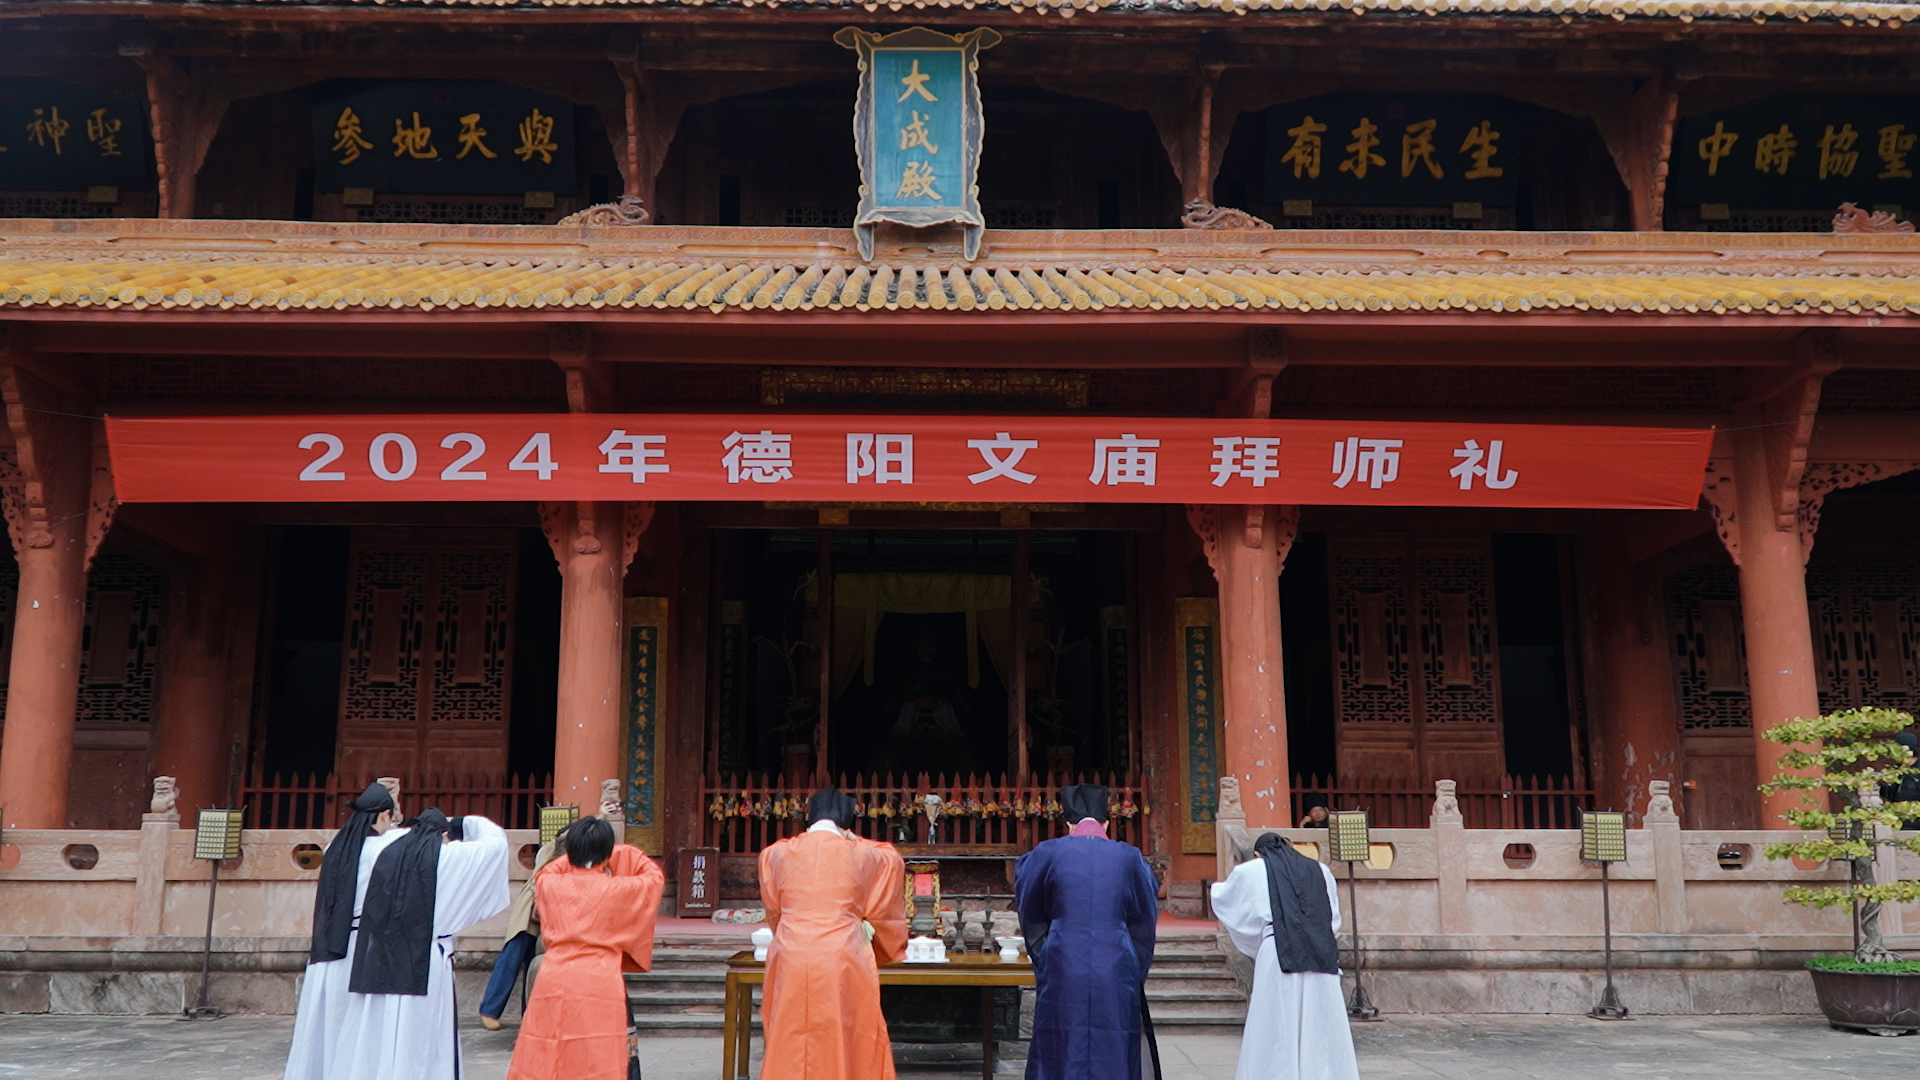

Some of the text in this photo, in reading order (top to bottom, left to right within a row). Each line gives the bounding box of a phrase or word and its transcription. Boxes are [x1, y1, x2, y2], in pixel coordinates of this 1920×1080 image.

[896, 58, 943, 201] 大成殿
[297, 429, 1520, 491] 2024年德阳文庙拜师礼
